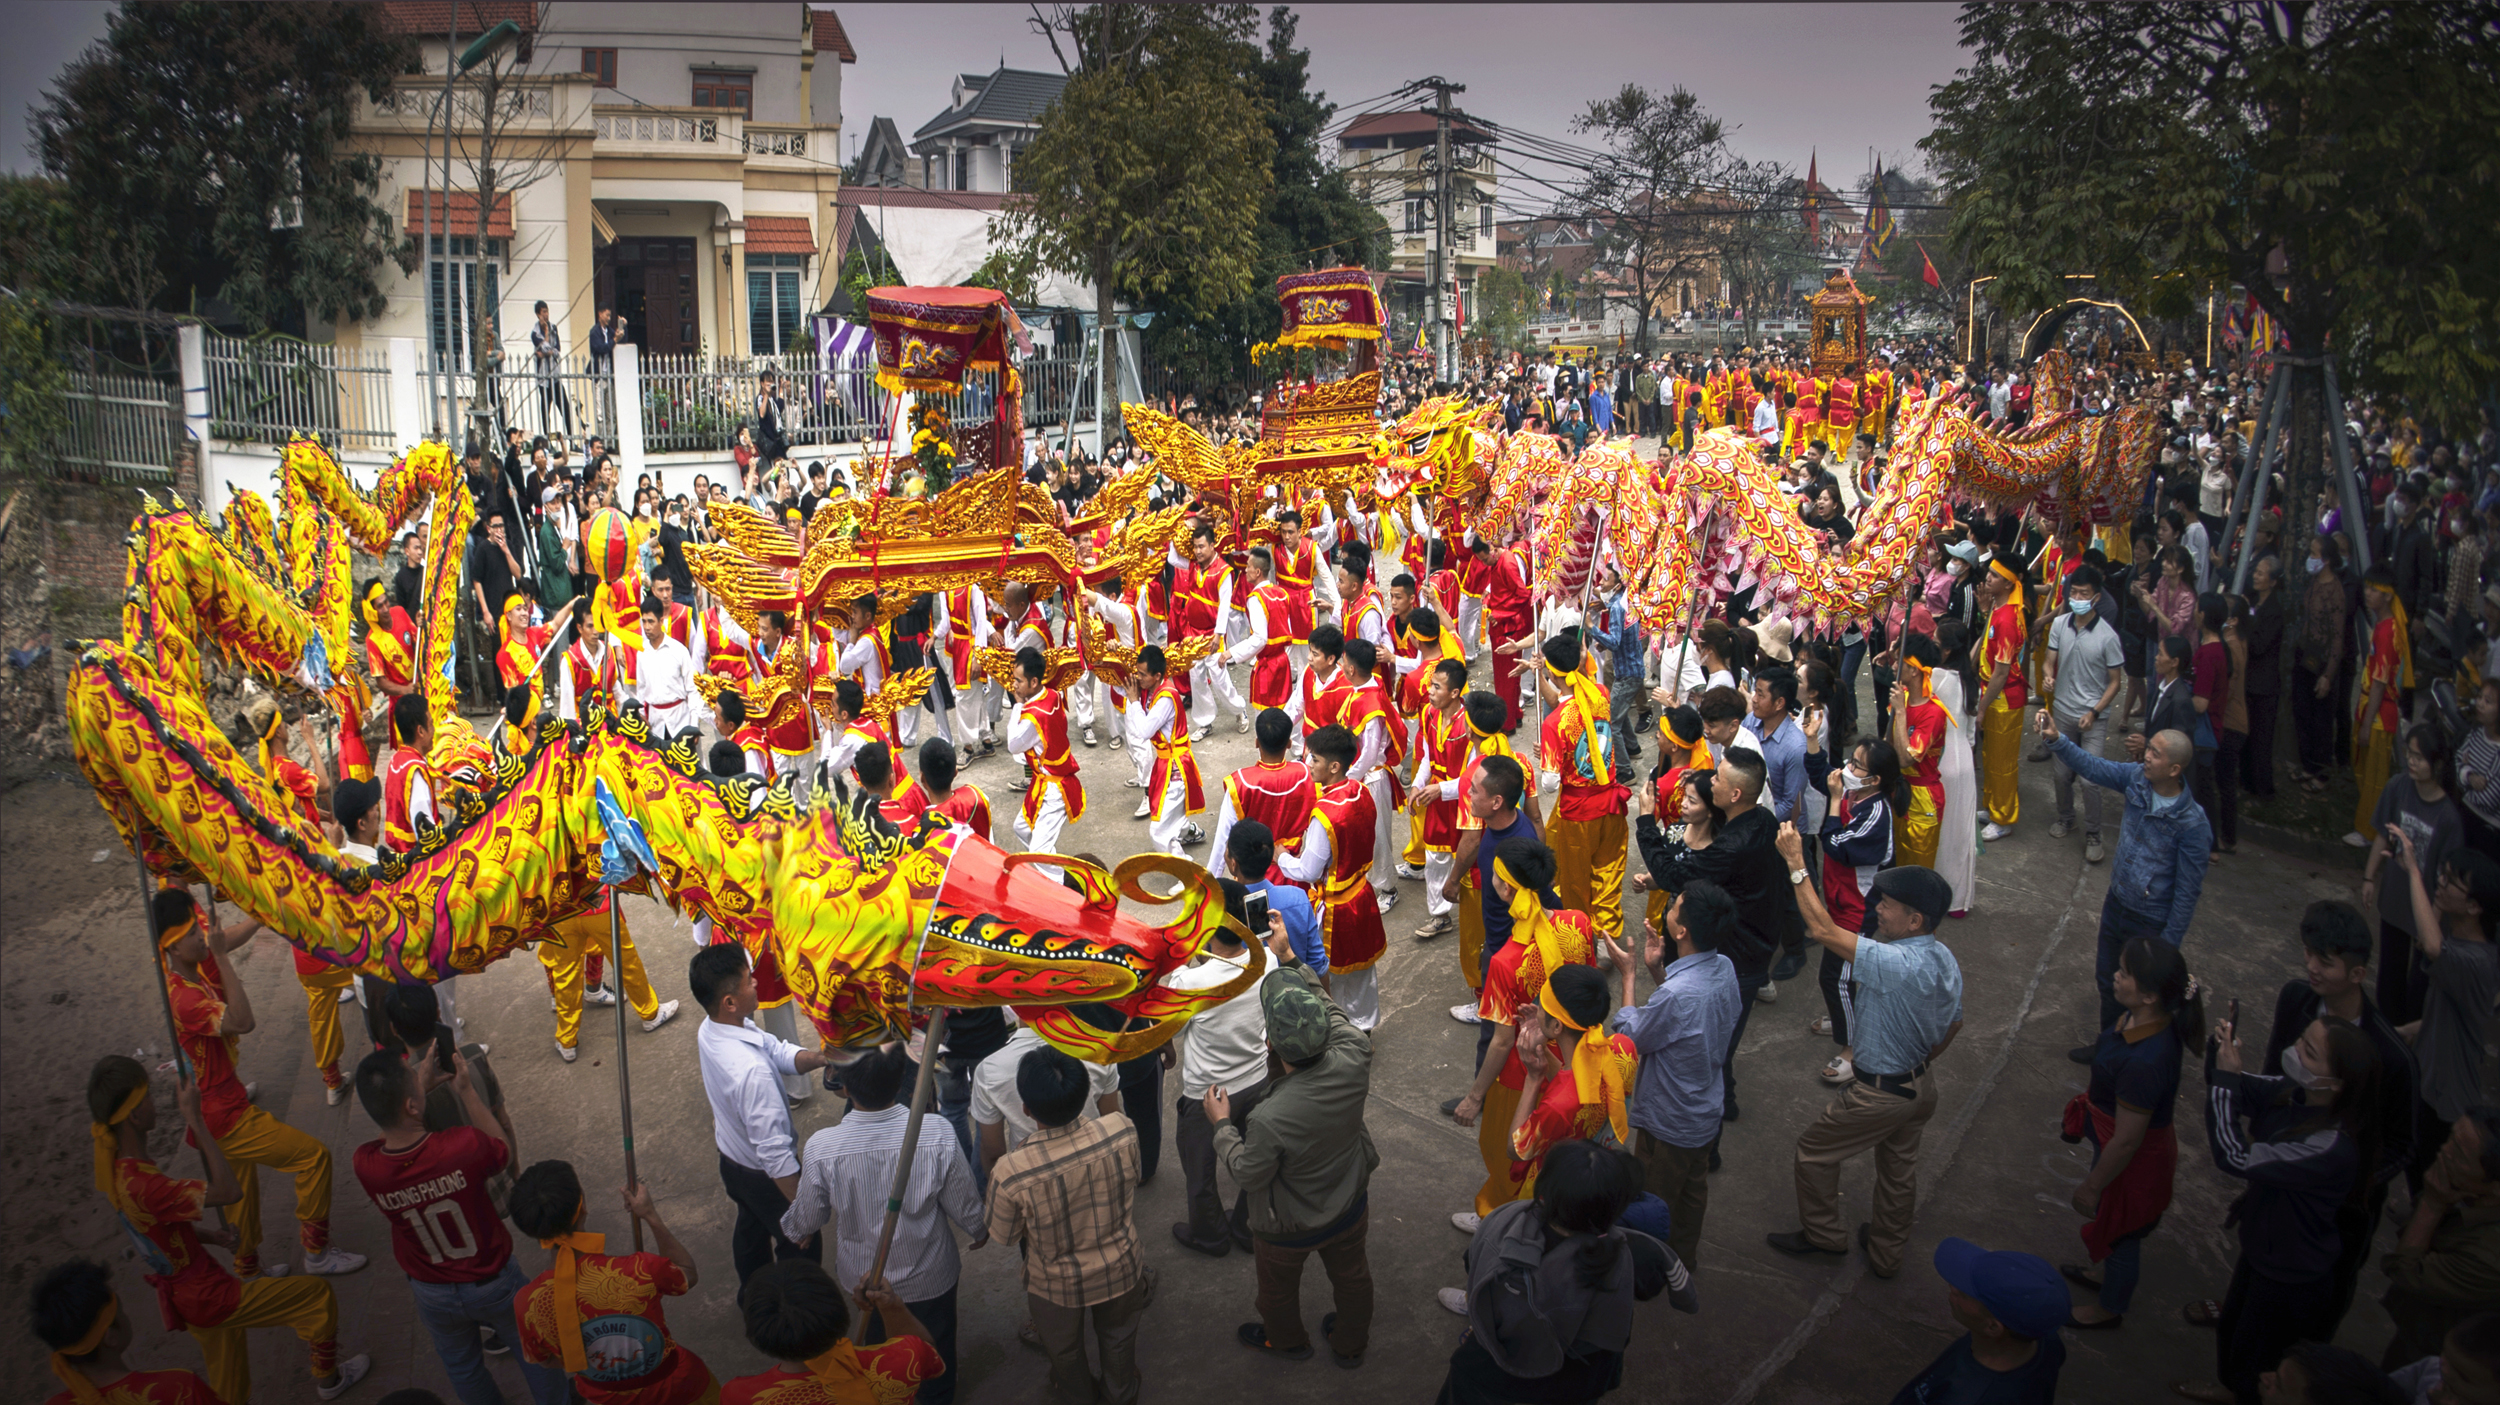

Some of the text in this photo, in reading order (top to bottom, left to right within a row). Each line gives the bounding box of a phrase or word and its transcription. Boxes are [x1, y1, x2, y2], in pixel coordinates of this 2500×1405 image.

[375, 1169, 468, 1211] N.CONG PHUONG
[401, 1198, 478, 1264] 10
